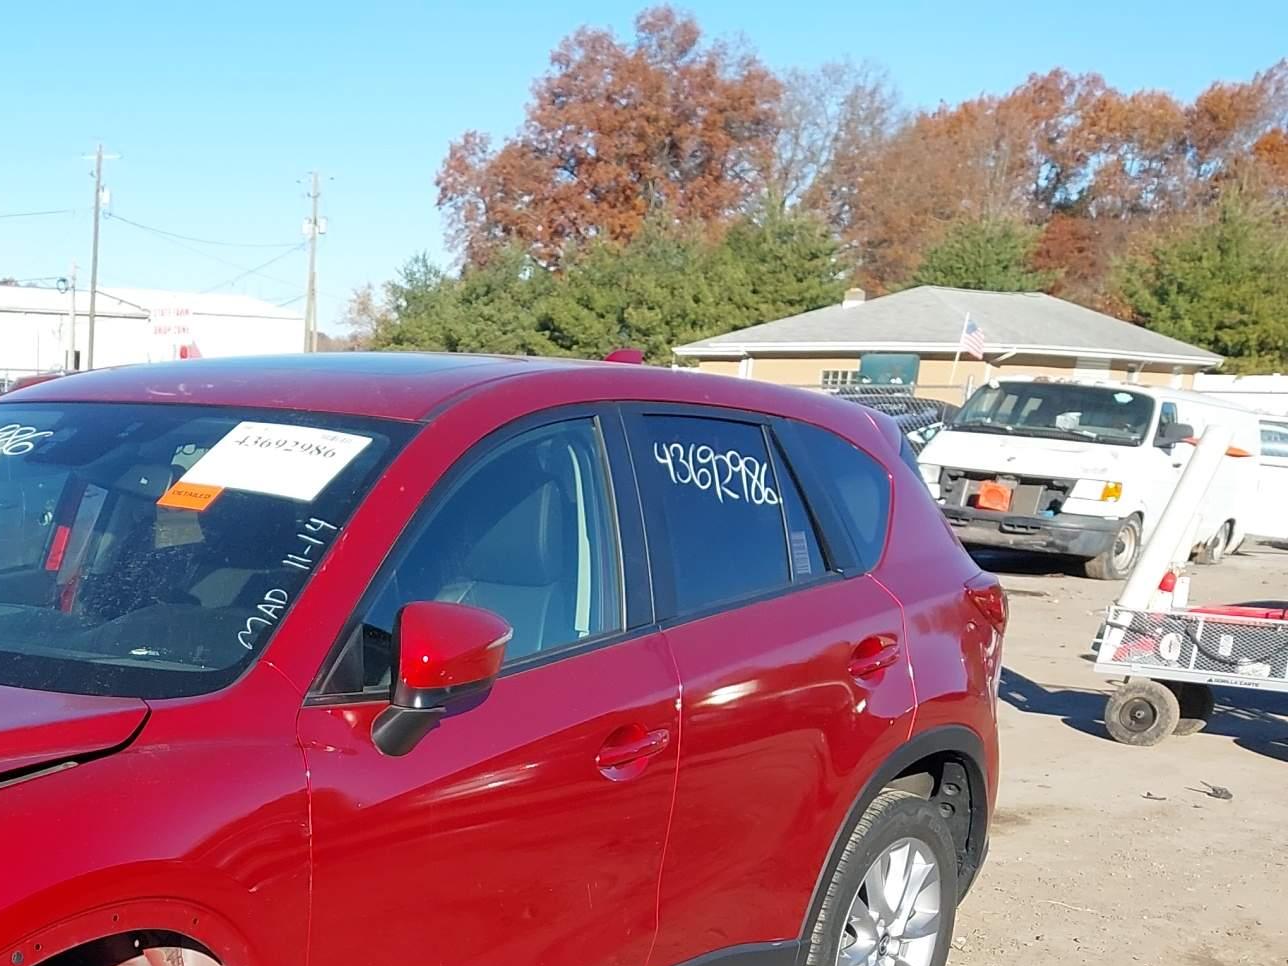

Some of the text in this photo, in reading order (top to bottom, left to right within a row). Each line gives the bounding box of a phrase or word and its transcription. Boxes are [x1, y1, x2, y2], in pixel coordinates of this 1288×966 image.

[234, 435, 337, 459] 43692986
[171, 488, 212, 500] DETAILED
[237, 588, 289, 650] MAD
